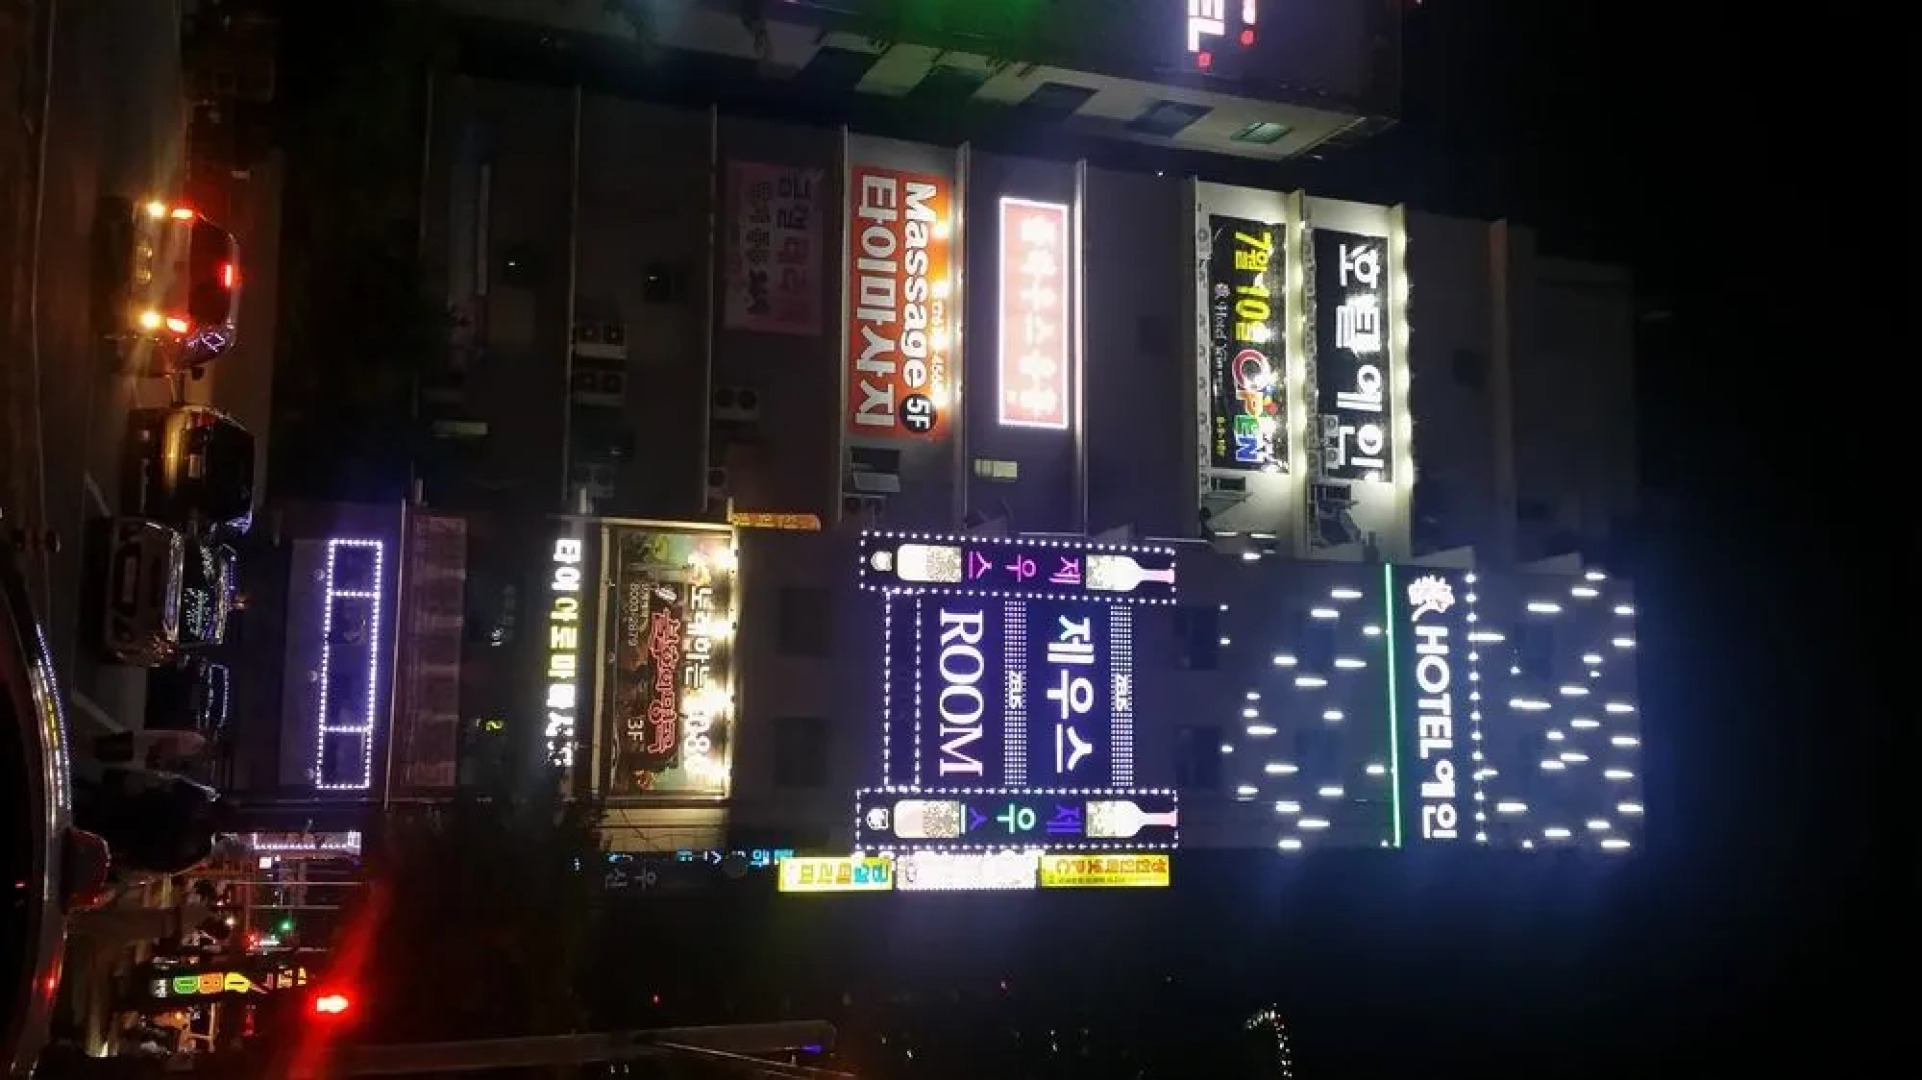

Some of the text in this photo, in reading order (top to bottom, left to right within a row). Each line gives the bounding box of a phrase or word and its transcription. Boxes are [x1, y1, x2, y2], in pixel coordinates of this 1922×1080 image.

[1235, 232, 1272, 271] 7월
[854, 174, 898, 427] 타이마사지
[900, 182, 937, 430] Massage 5F
[1232, 350, 1276, 462] OPEN
[968, 551, 1081, 585] 제우스
[684, 584, 714, 690] 노래하는
[939, 608, 984, 777] ROOM
[1008, 670, 1023, 710] ZEUS
[1046, 615, 1094, 774] 제우스
[1115, 673, 1129, 712] ZEUS
[626, 718, 644, 742] 3F
[960, 804, 1082, 835] 제우스
